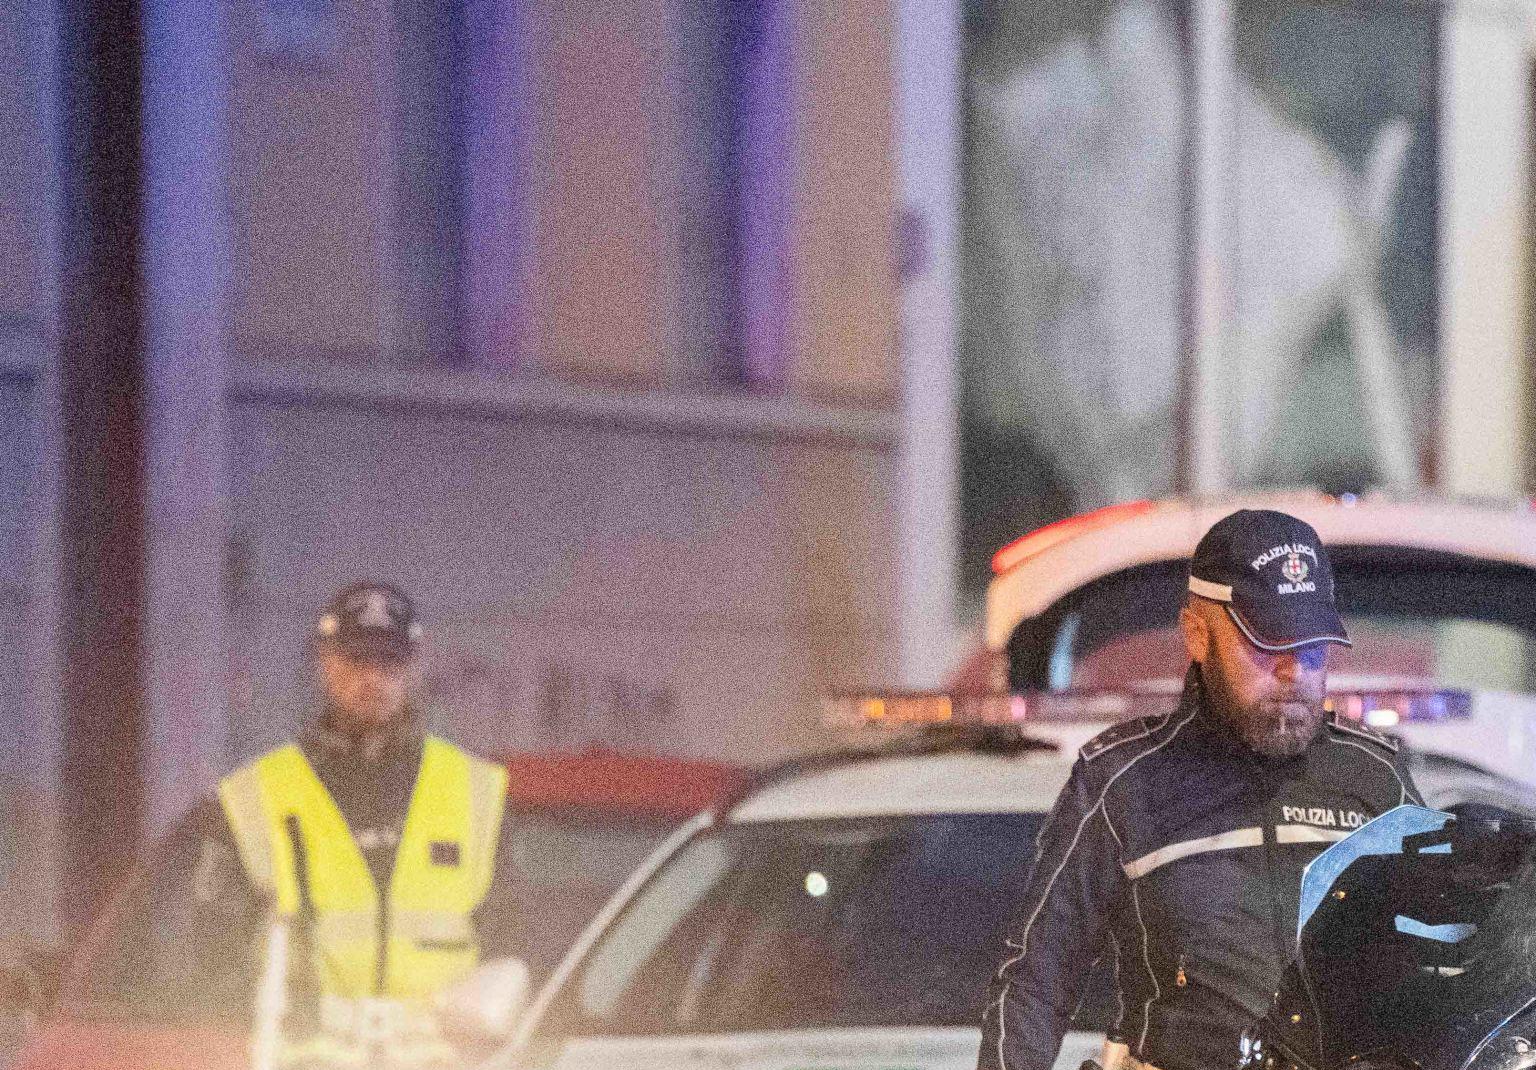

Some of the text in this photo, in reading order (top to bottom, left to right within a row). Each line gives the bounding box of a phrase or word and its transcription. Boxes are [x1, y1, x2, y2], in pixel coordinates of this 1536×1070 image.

[1251, 543, 1293, 571] POLIZIA
[1277, 581, 1317, 595] MILANO
[1282, 805, 1369, 828] POLIZIA LOC
